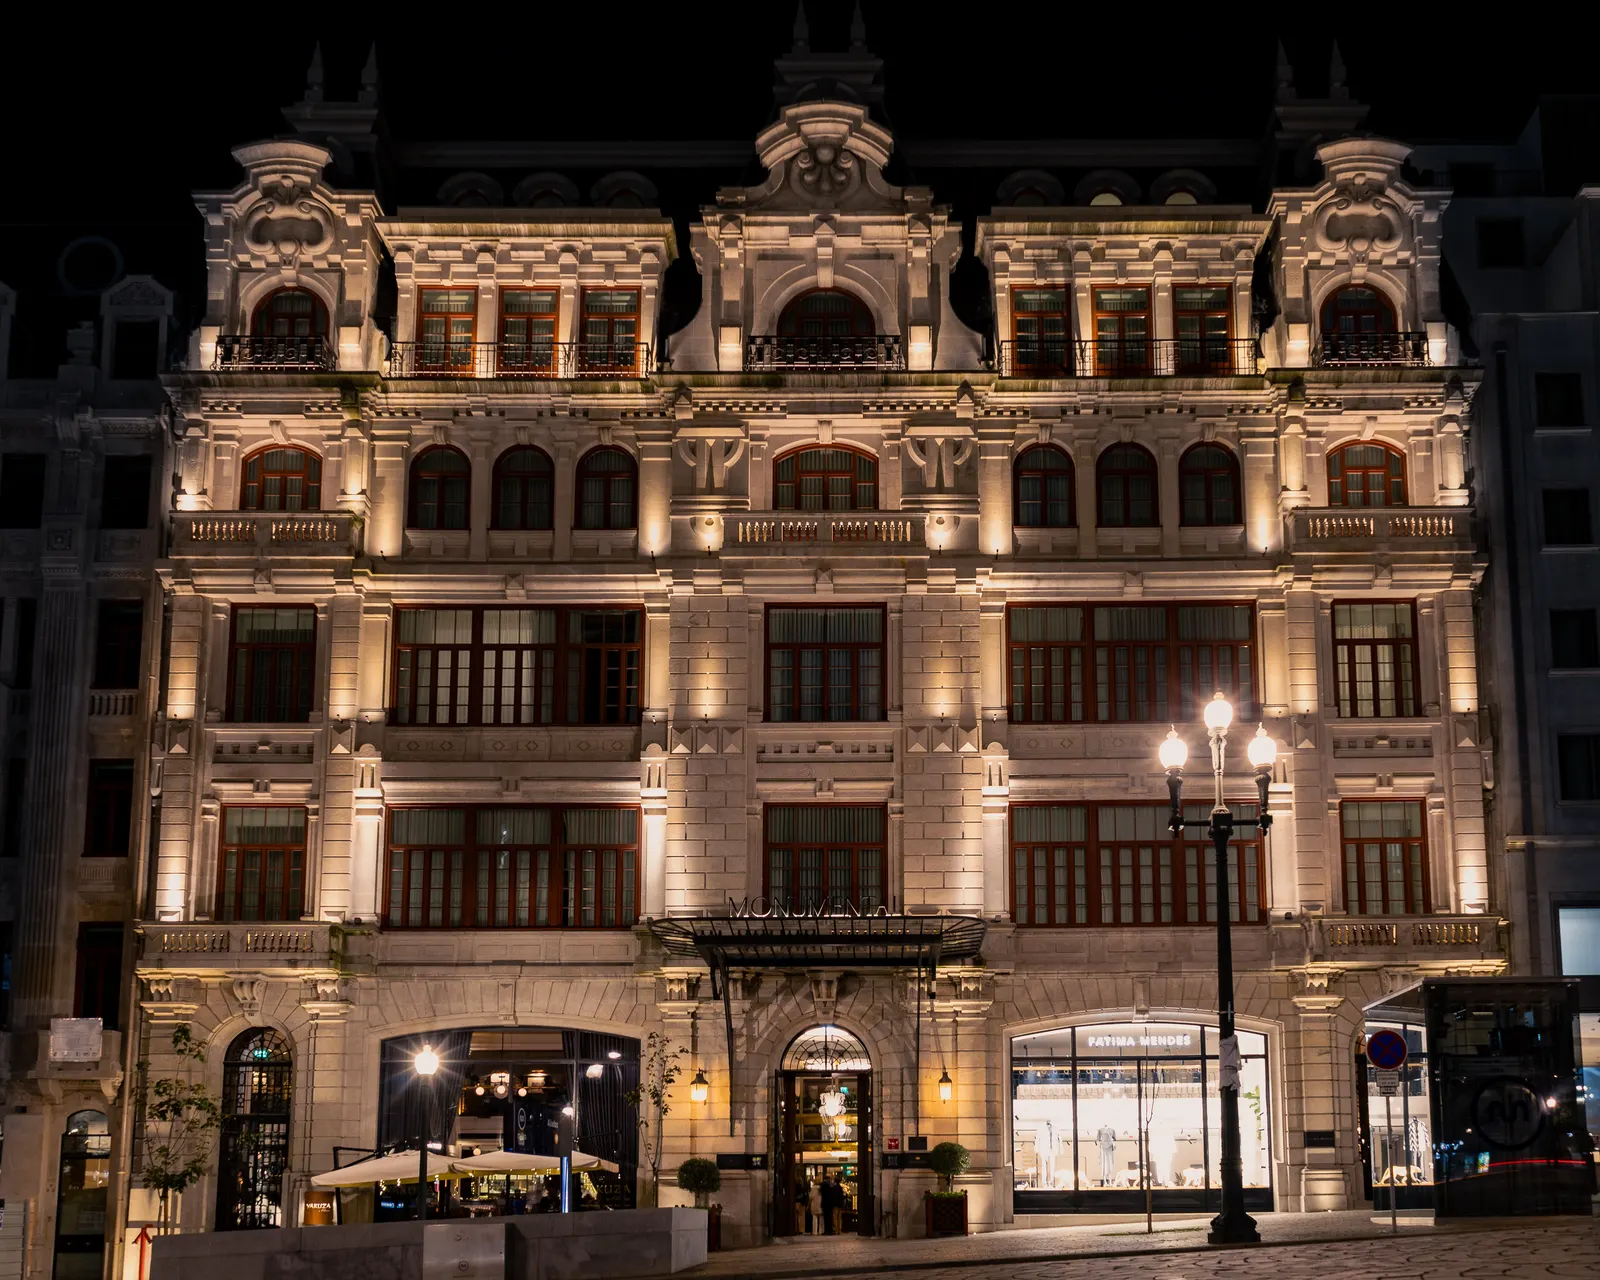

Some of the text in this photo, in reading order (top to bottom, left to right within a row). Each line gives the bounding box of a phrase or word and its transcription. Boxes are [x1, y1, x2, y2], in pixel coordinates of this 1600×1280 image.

[728, 895, 902, 918] MONUMENTAL
[1087, 1035, 1192, 1047] FATIMA MENDES
[305, 1202, 332, 1210] YAKUZA
